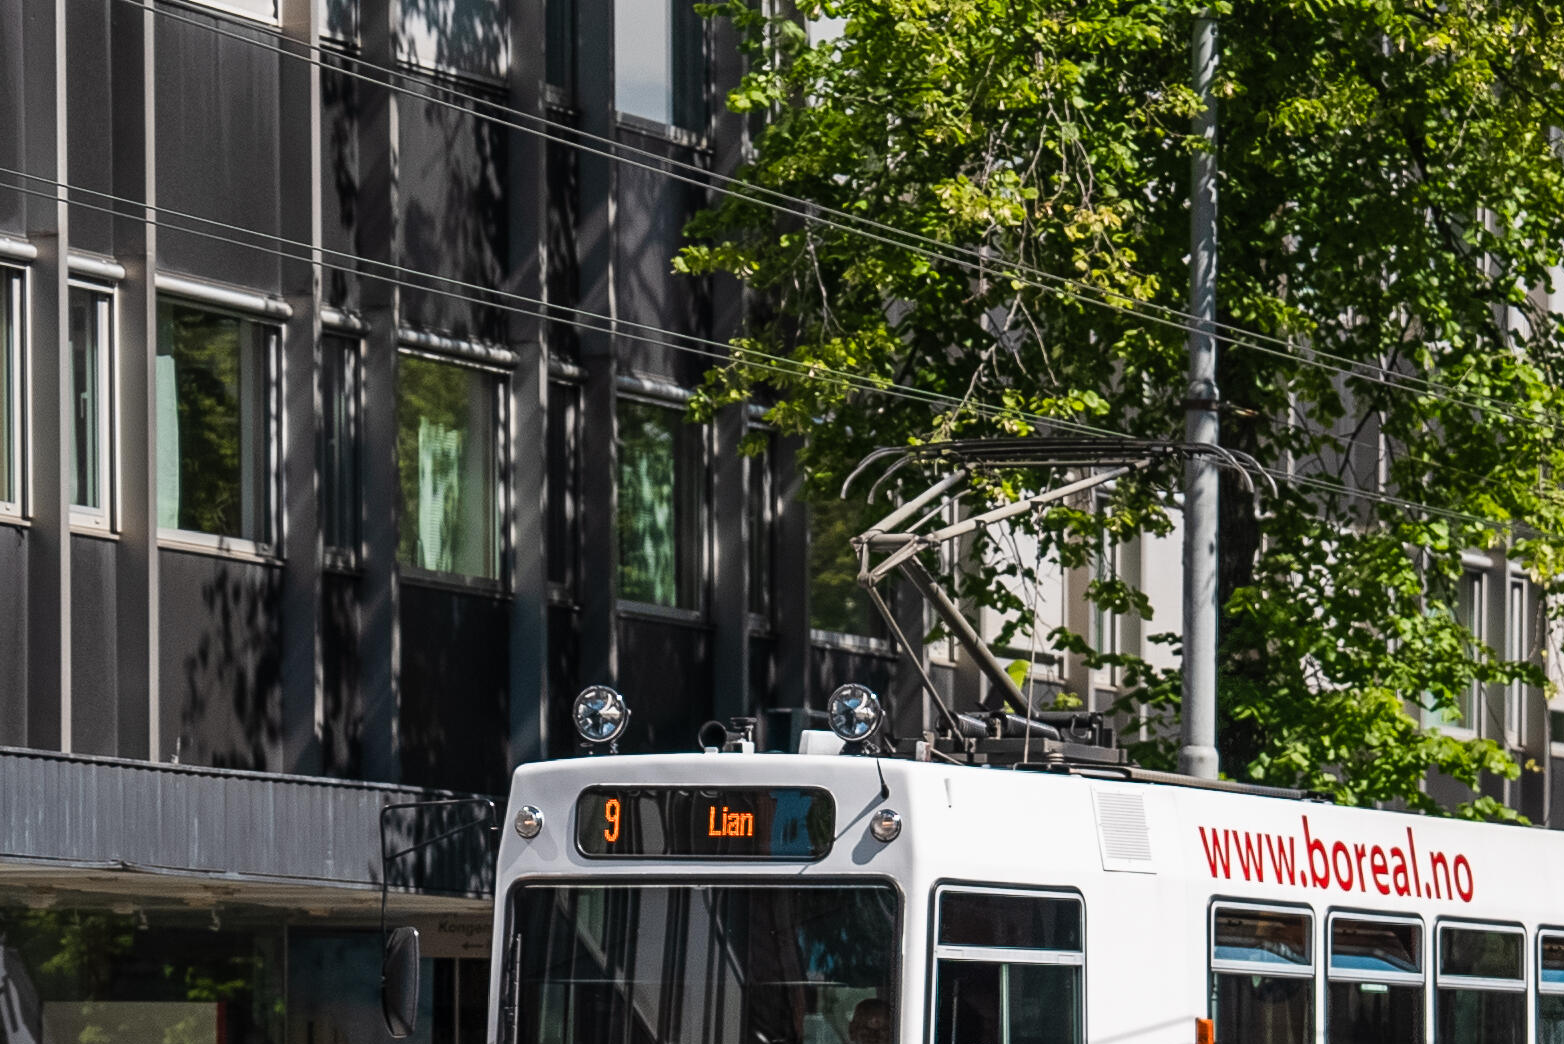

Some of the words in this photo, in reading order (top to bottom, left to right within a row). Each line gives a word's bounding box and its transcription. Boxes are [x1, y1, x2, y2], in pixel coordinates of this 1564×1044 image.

[604, 799, 621, 842] 9
[708, 806, 754, 837] Lian
[1198, 815, 1474, 903] www.boreal.no
